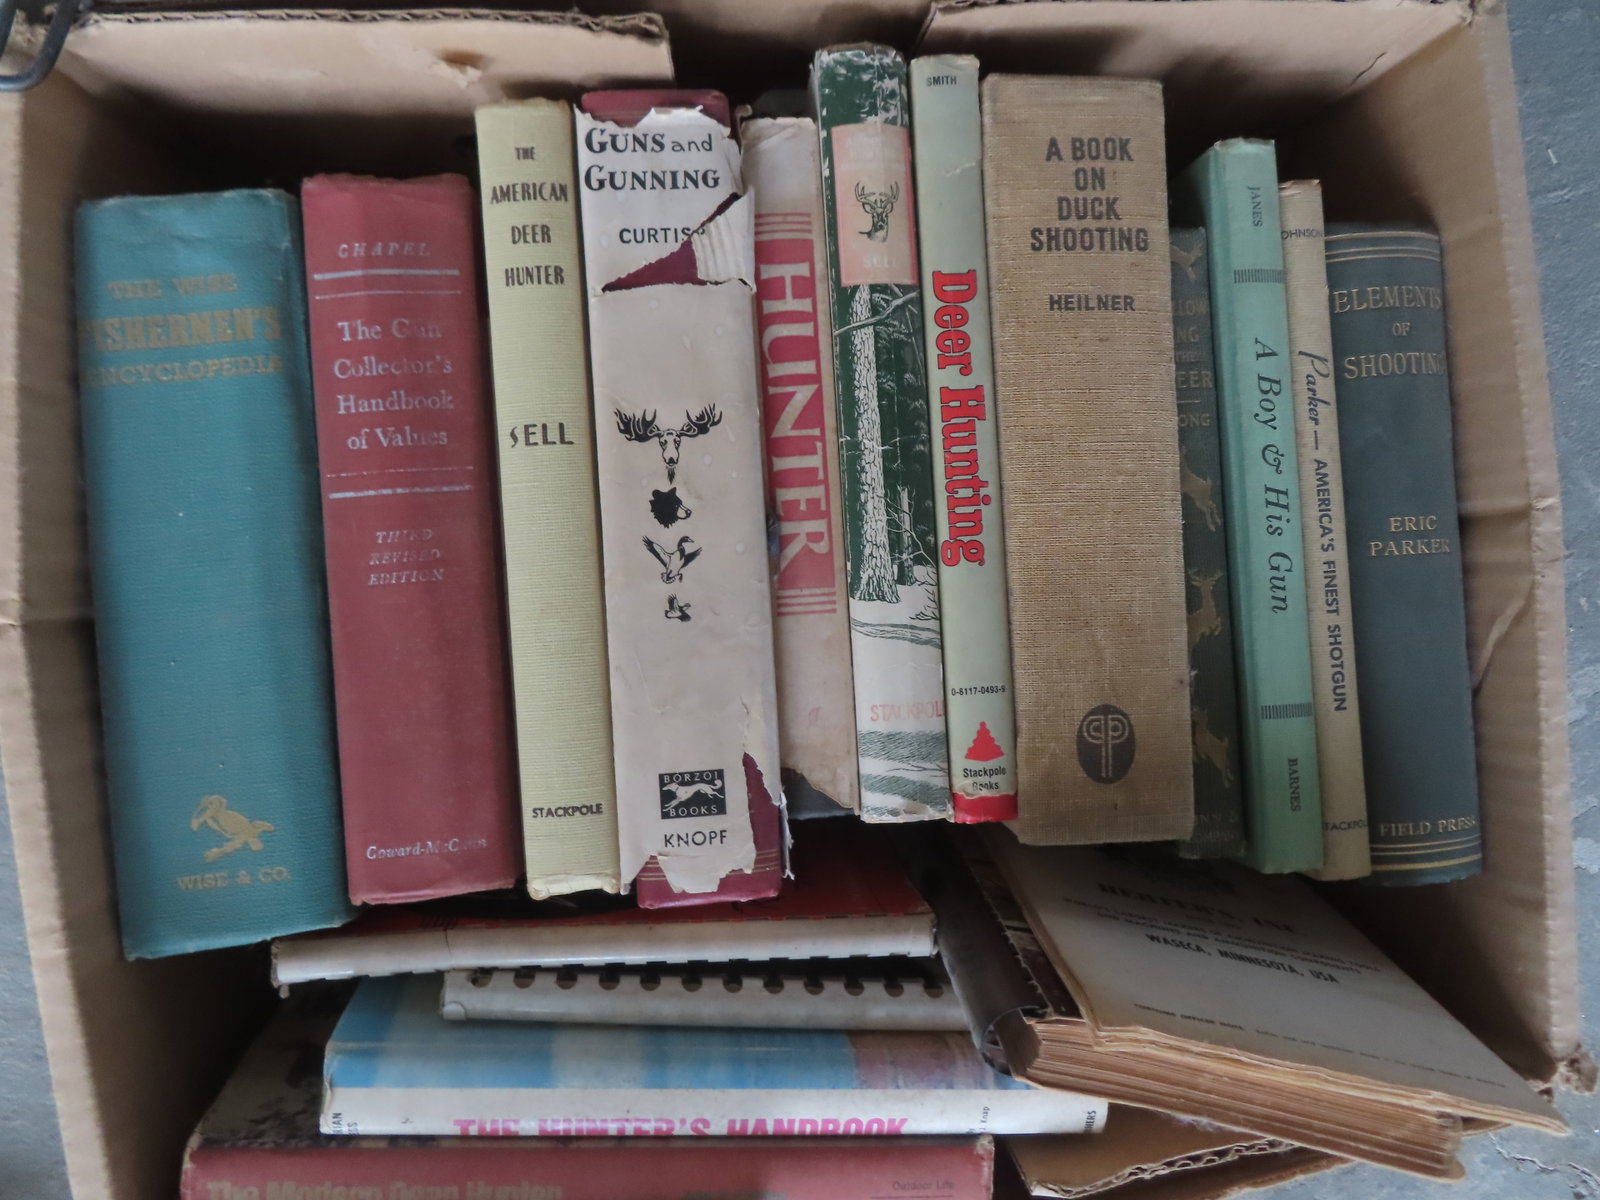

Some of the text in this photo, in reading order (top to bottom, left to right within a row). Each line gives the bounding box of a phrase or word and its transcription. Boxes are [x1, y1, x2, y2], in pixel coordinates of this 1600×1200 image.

[926, 75, 957, 86] SMITH
[585, 128, 713, 153] GUNS and
[1045, 137, 1133, 161] A BOOK
[514, 146, 536, 161] THE
[584, 165, 720, 191] GUNNING
[1074, 167, 1106, 191] ON
[490, 182, 568, 205] AMERICAN
[1057, 196, 1122, 221] DUCK
[1247, 185, 1263, 227] JANES
[511, 224, 551, 244] DEER
[619, 227, 691, 244] CURTIS
[1030, 227, 1149, 252] SHOOTING
[1281, 228, 1324, 240] OHNSON
[337, 242, 430, 259] CHAPEL
[505, 265, 564, 287] HUNTER
[1049, 294, 1136, 312] HEILNER
[1334, 286, 1442, 313] ELEMENTS
[337, 320, 382, 342] The
[1391, 322, 1411, 336] OF
[333, 354, 453, 379] Collector's
[1177, 371, 1215, 389] EER
[337, 391, 454, 414] Handbook
[760, 261, 831, 574] HUNTER
[932, 269, 991, 567] Deer Hunting
[1178, 413, 1212, 427] ONG
[347, 426, 448, 450] of Values
[509, 421, 574, 448] SELL
[1253, 337, 1294, 613] A Boy & His Gun
[1313, 458, 1335, 552] AMERICA'S
[1389, 515, 1438, 532] ERIC
[1370, 539, 1451, 557] PARKER
[367, 568, 445, 586] EDITION
[1322, 560, 1340, 616] FINEST
[1328, 624, 1347, 712] SHOTGUN
[870, 700, 945, 722] STACKPOL
[664, 771, 718, 783] BORZOI
[963, 765, 1007, 779] Stackpole
[1287, 757, 1302, 812] BARNES
[532, 803, 603, 819] STACKPOLE
[669, 805, 718, 817] BOOKS
[664, 829, 727, 848] KNOPF
[1379, 821, 1431, 837] FIELD
[176, 872, 229, 890] WISE
